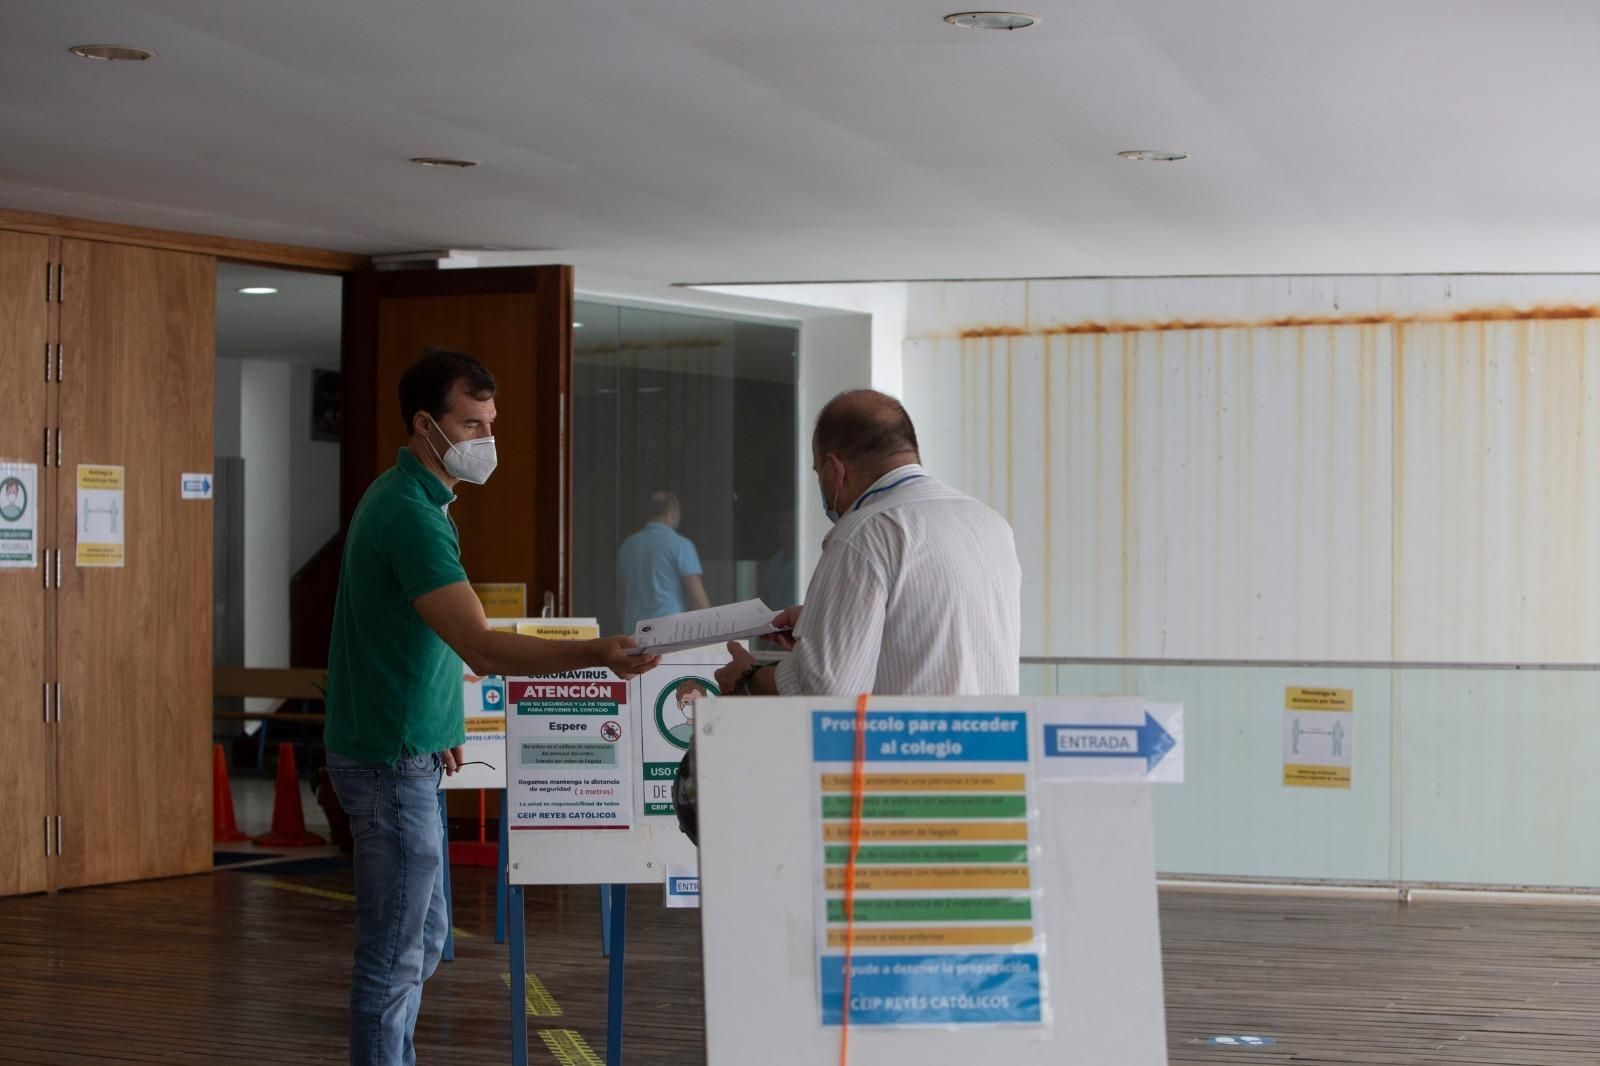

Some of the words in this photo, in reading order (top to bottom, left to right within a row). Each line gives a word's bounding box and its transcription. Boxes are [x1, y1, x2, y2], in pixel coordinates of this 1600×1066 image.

[524, 683, 612, 698] ATENCIÓN
[549, 722, 588, 732] Espere
[908, 718, 947, 734] para
[952, 716, 1018, 732] acceder
[880, 740, 896, 754] al
[900, 740, 962, 758] colegio
[1060, 735, 1130, 750] ENTRADA
[650, 768, 671, 776] USO
[653, 785, 667, 798] DE
[677, 882, 699, 892] ENTR
[850, 997, 883, 1010] CEIP
[885, 996, 926, 1010] REYES
[929, 994, 1009, 1009] CATÓLICOS
